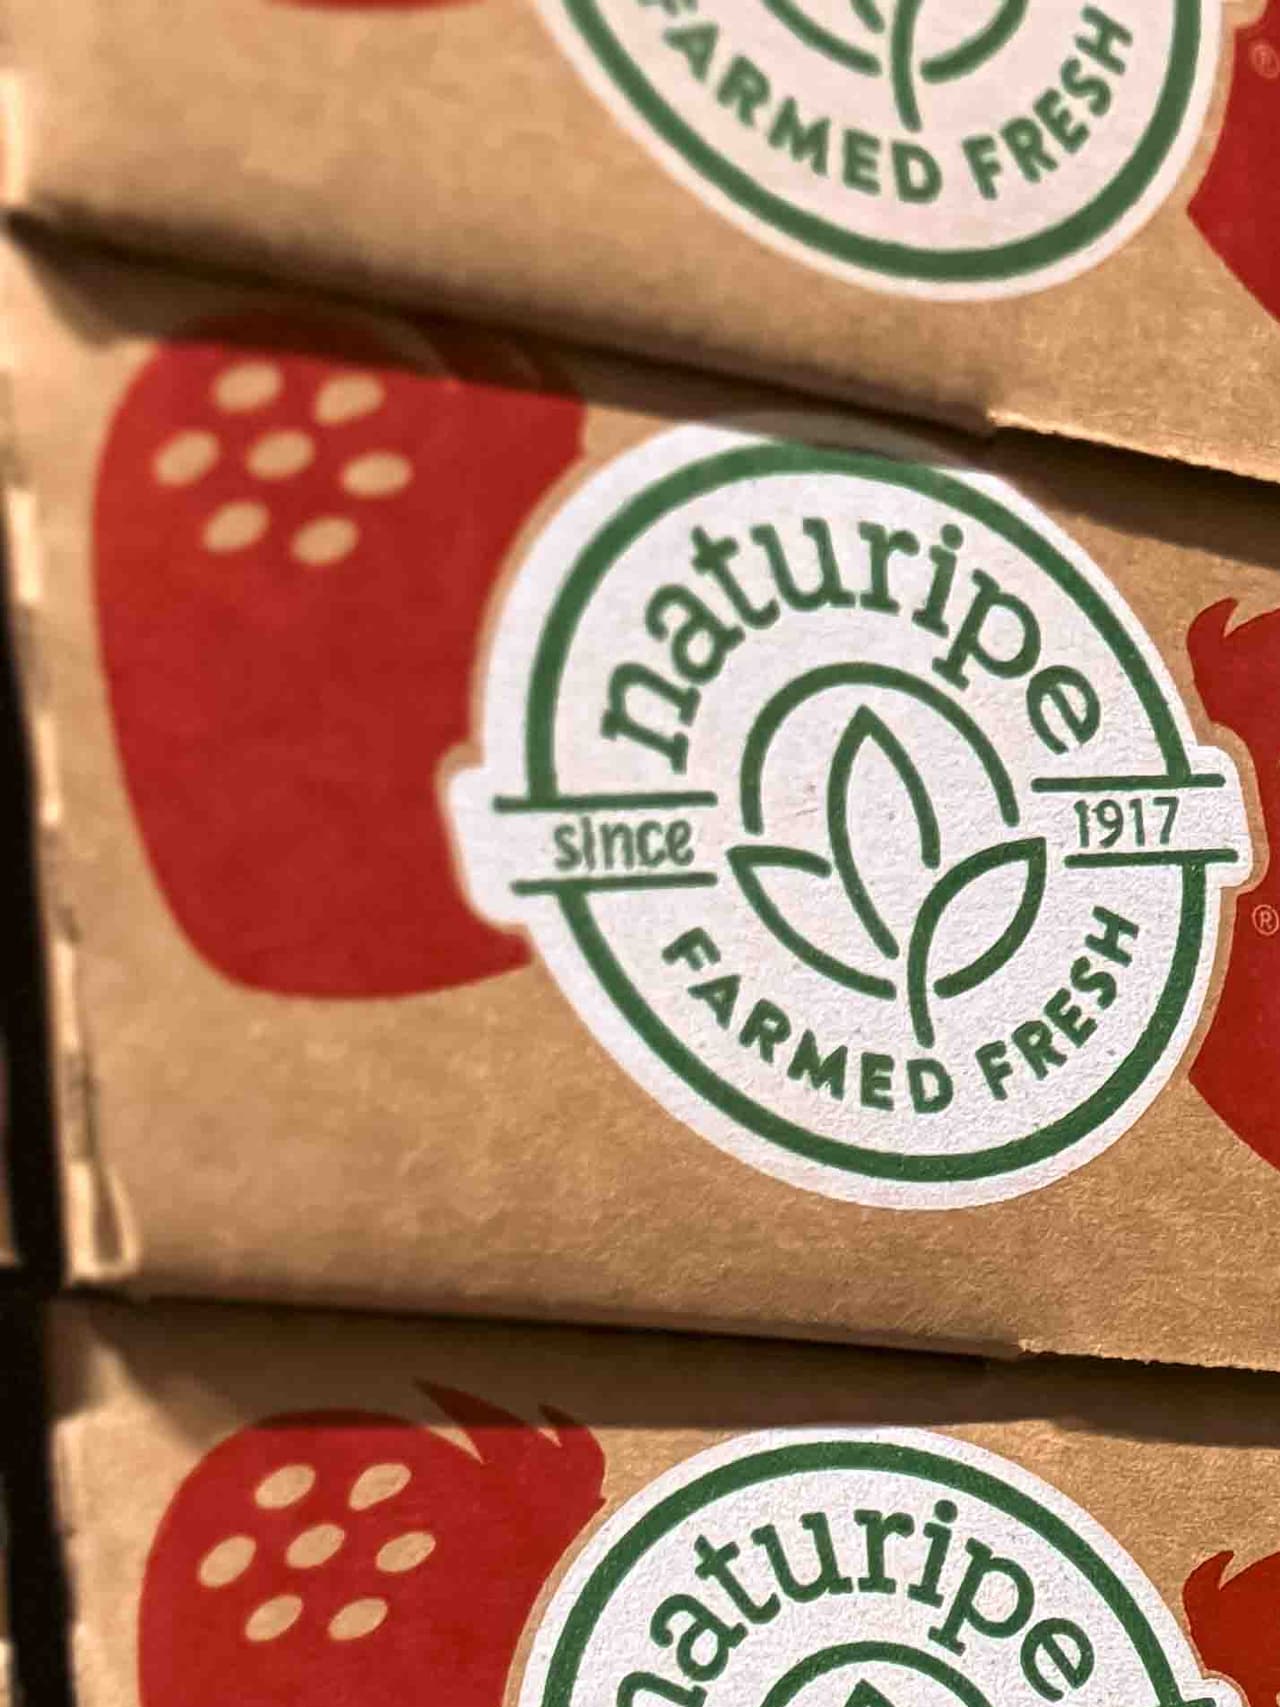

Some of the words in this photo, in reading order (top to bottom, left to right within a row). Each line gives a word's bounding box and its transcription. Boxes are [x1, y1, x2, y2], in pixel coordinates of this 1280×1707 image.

[962, 7, 1134, 200] FRESH
[599, 517, 1102, 775] naturipe
[554, 817, 695, 870] since
[1074, 797, 1182, 848] 1917
[661, 926, 955, 1115] FARMED
[975, 905, 1141, 1101] FRESH
